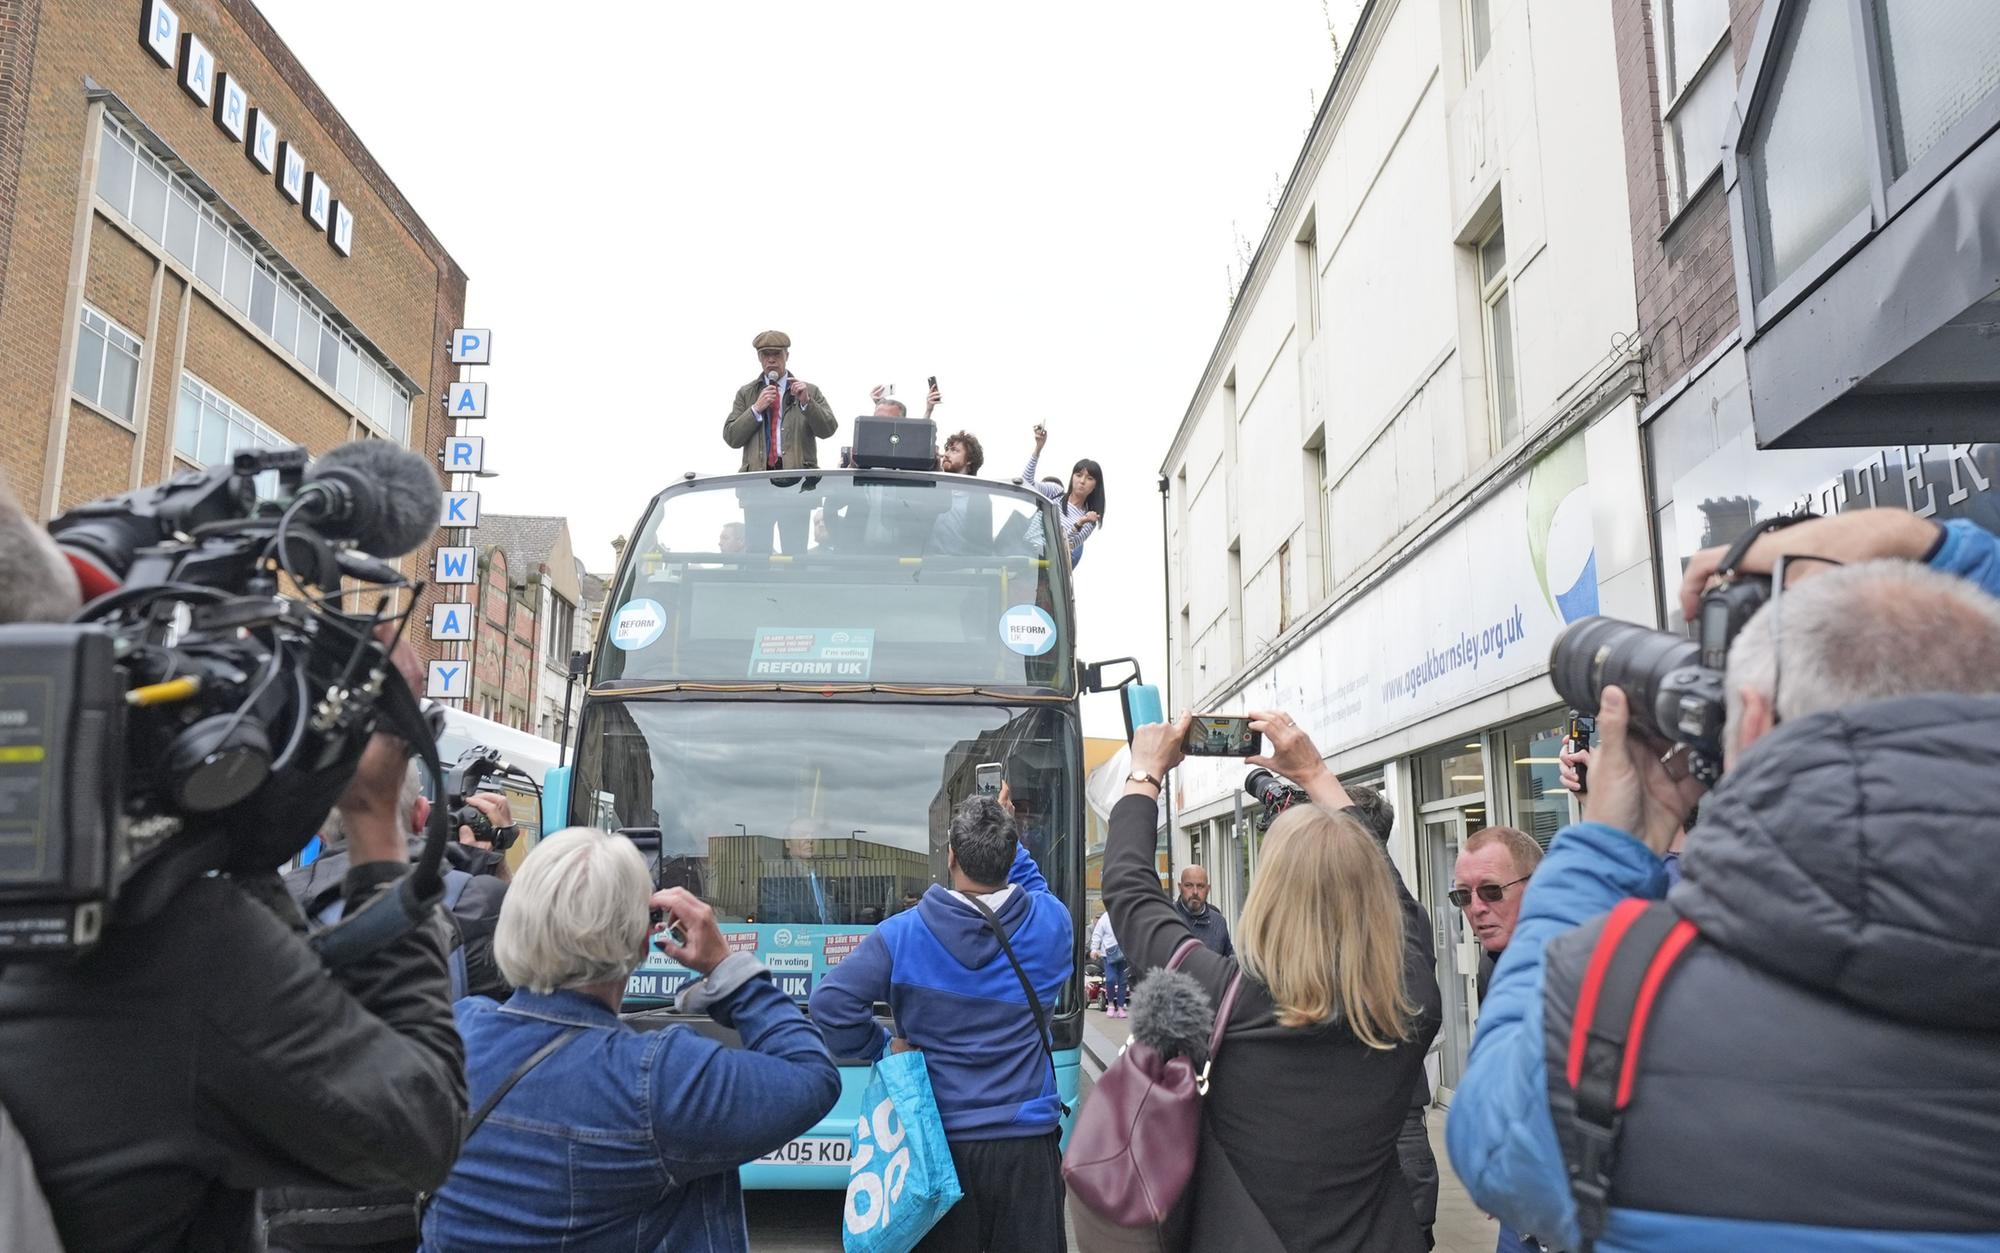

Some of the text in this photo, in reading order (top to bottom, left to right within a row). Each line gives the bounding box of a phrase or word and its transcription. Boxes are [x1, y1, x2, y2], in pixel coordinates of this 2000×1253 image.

[156, 7, 350, 243] PARKWAY
[437, 334, 480, 691] PARKWAY
[620, 619, 655, 628] REFORM
[1010, 625, 1046, 634] REFORM
[618, 629, 629, 637] UK
[1010, 633, 1021, 641] UK
[1381, 603, 1525, 704] www.ageukbarnsley.org.uk
[757, 661, 862, 674] REFORM UK
[769, 957, 809, 967] I'm voting
[783, 977, 807, 996] UK
[761, 1142, 812, 1161] X05
